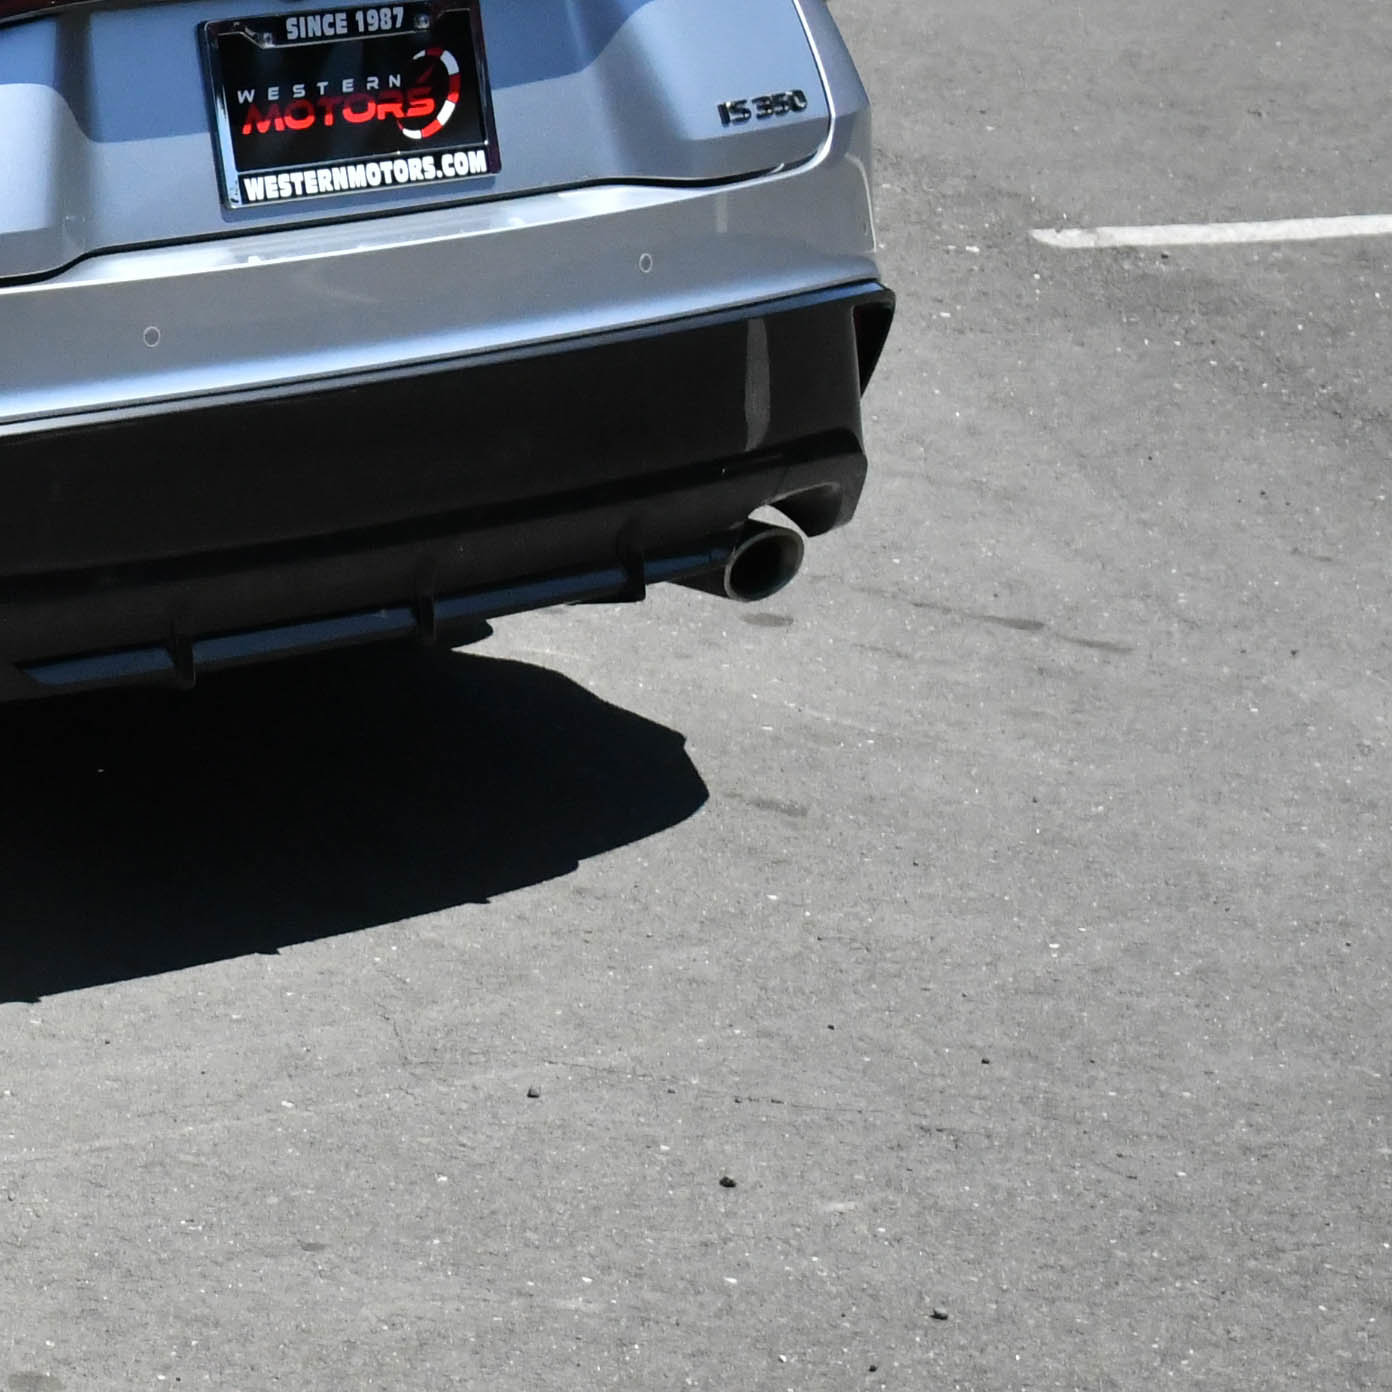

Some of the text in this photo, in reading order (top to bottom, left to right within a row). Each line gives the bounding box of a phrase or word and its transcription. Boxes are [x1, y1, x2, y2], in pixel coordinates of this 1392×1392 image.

[285, 6, 404, 40] SINCE 1987
[237, 73, 402, 104] WESTERN
[241, 87, 436, 136] MOTORS
[717, 89, 808, 127] IS 350
[243, 150, 488, 202] WESTERNMOTORS.COM
